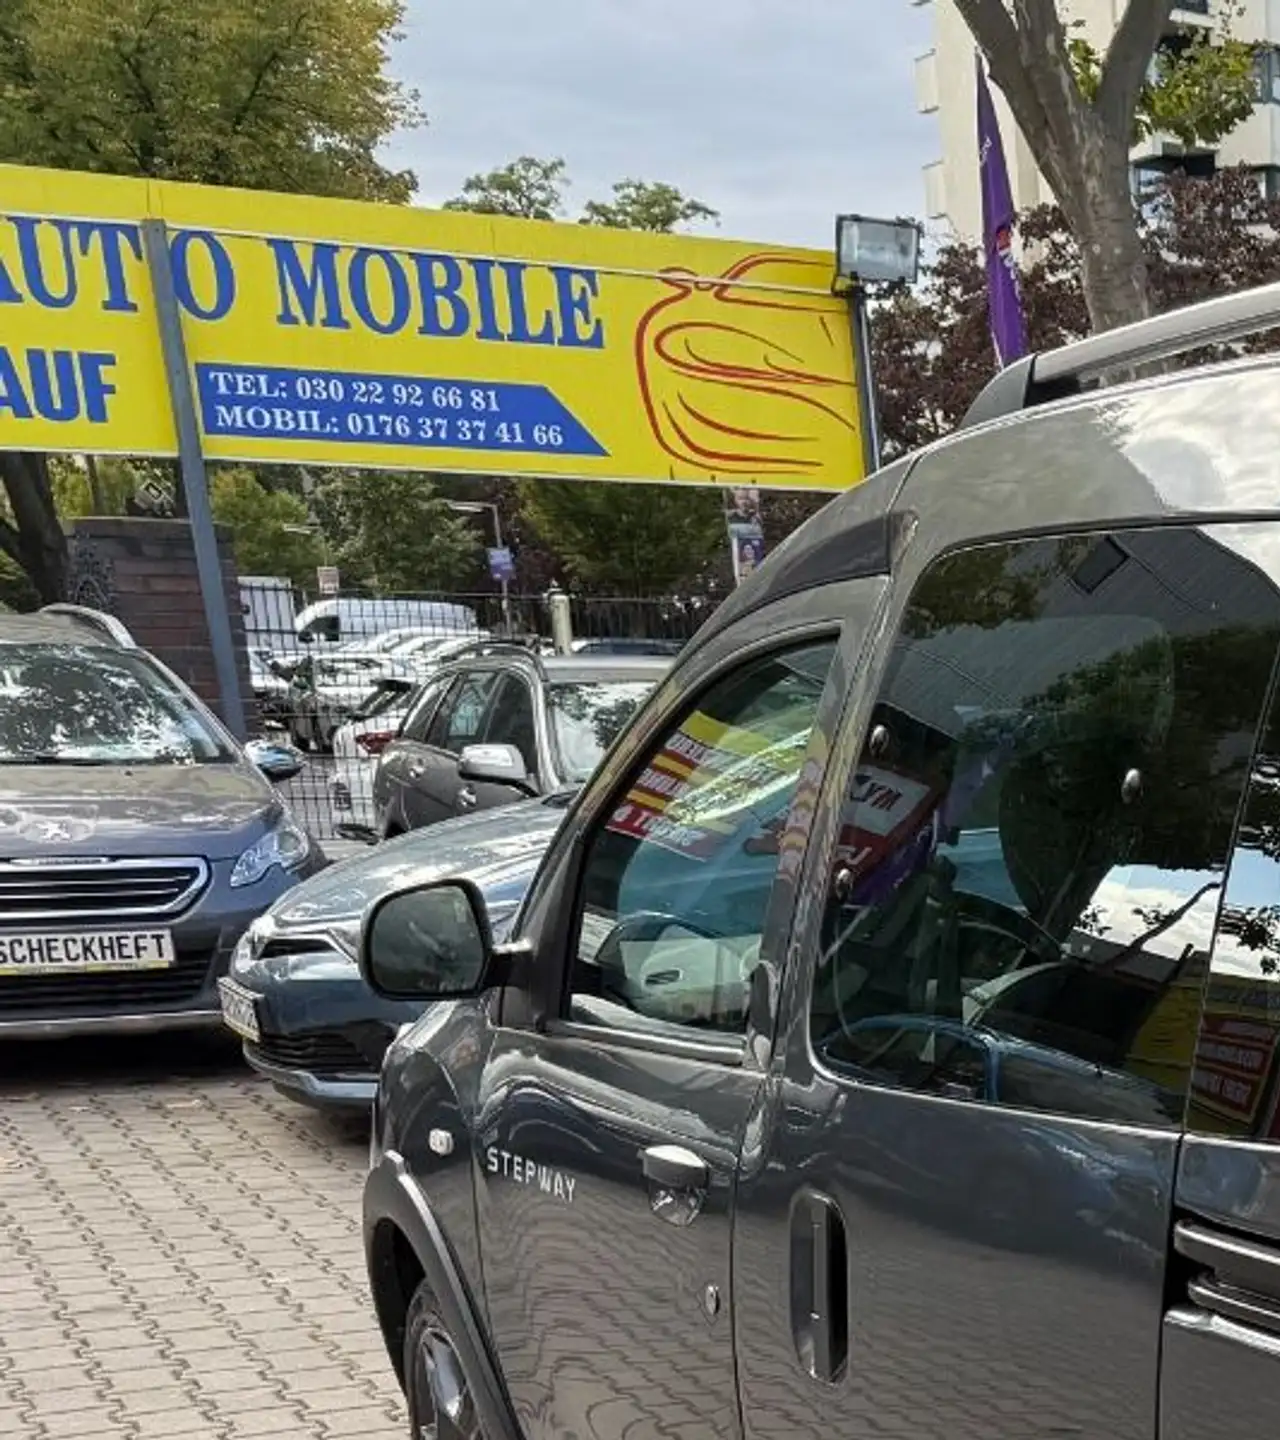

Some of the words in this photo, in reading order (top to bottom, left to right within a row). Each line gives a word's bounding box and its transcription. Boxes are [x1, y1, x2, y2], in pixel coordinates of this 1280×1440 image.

[266, 237, 605, 350] MOBILE
[209, 371, 288, 399] TEL:
[296, 376, 345, 402] 030
[352, 380, 383, 405] 22
[393, 383, 424, 408] 92
[432, 385, 463, 410] 66
[471, 387, 500, 412] 81
[215, 405, 339, 434] MOBIL:
[348, 412, 411, 439] 0176
[418, 417, 449, 441] 37
[457, 419, 488, 443] 37
[494, 421, 525, 445] 41
[532, 422, 564, 447] 66
[487, 1147, 577, 1203] STEPWAY
